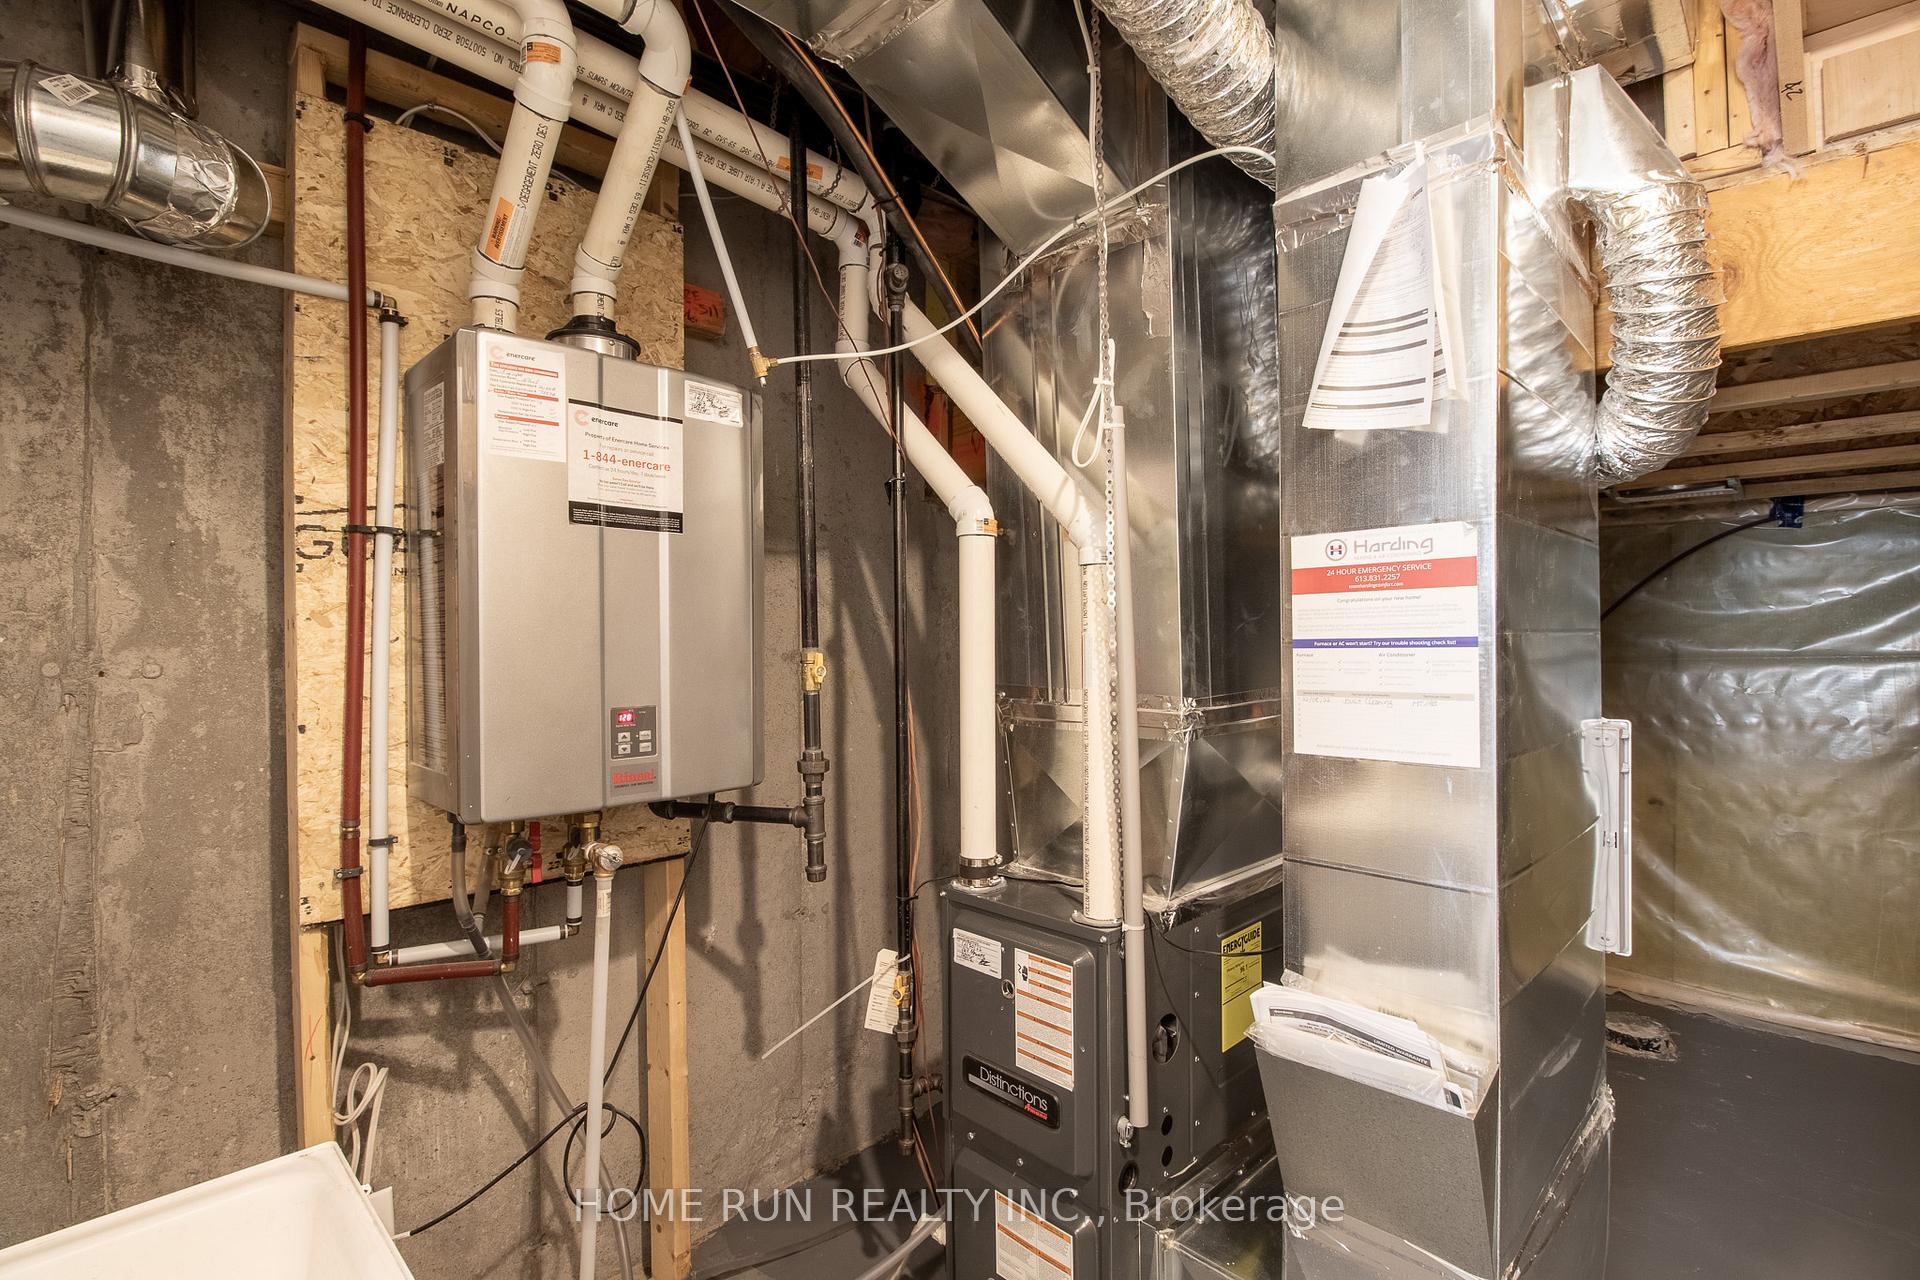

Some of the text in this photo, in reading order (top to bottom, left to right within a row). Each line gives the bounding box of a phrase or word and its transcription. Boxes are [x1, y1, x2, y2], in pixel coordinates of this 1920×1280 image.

[386, 2, 430, 30] CLEARANCE
[446, 3, 506, 36] NAPCO
[433, 24, 453, 41] ZERO
[535, 122, 548, 139] DES
[530, 140, 544, 159] ZERO
[506, 351, 536, 361] enercare
[591, 417, 618, 427] enercare
[585, 431, 605, 440] Property
[612, 437, 633, 445] Enercare
[648, 442, 670, 450] Services
[583, 449, 671, 471] 1-844-enercare
[1354, 536, 1433, 555] Harding
[1336, 568, 1357, 576] HOUR
[1357, 565, 1401, 575] EMERGENCY
[1402, 562, 1432, 571] SERVICE
[1355, 573, 1401, 582] 613.831.2257
[1373, 1039, 1428, 1065] LIMITED WARRANTY
[980, 1066, 1048, 1111] Distinctions
